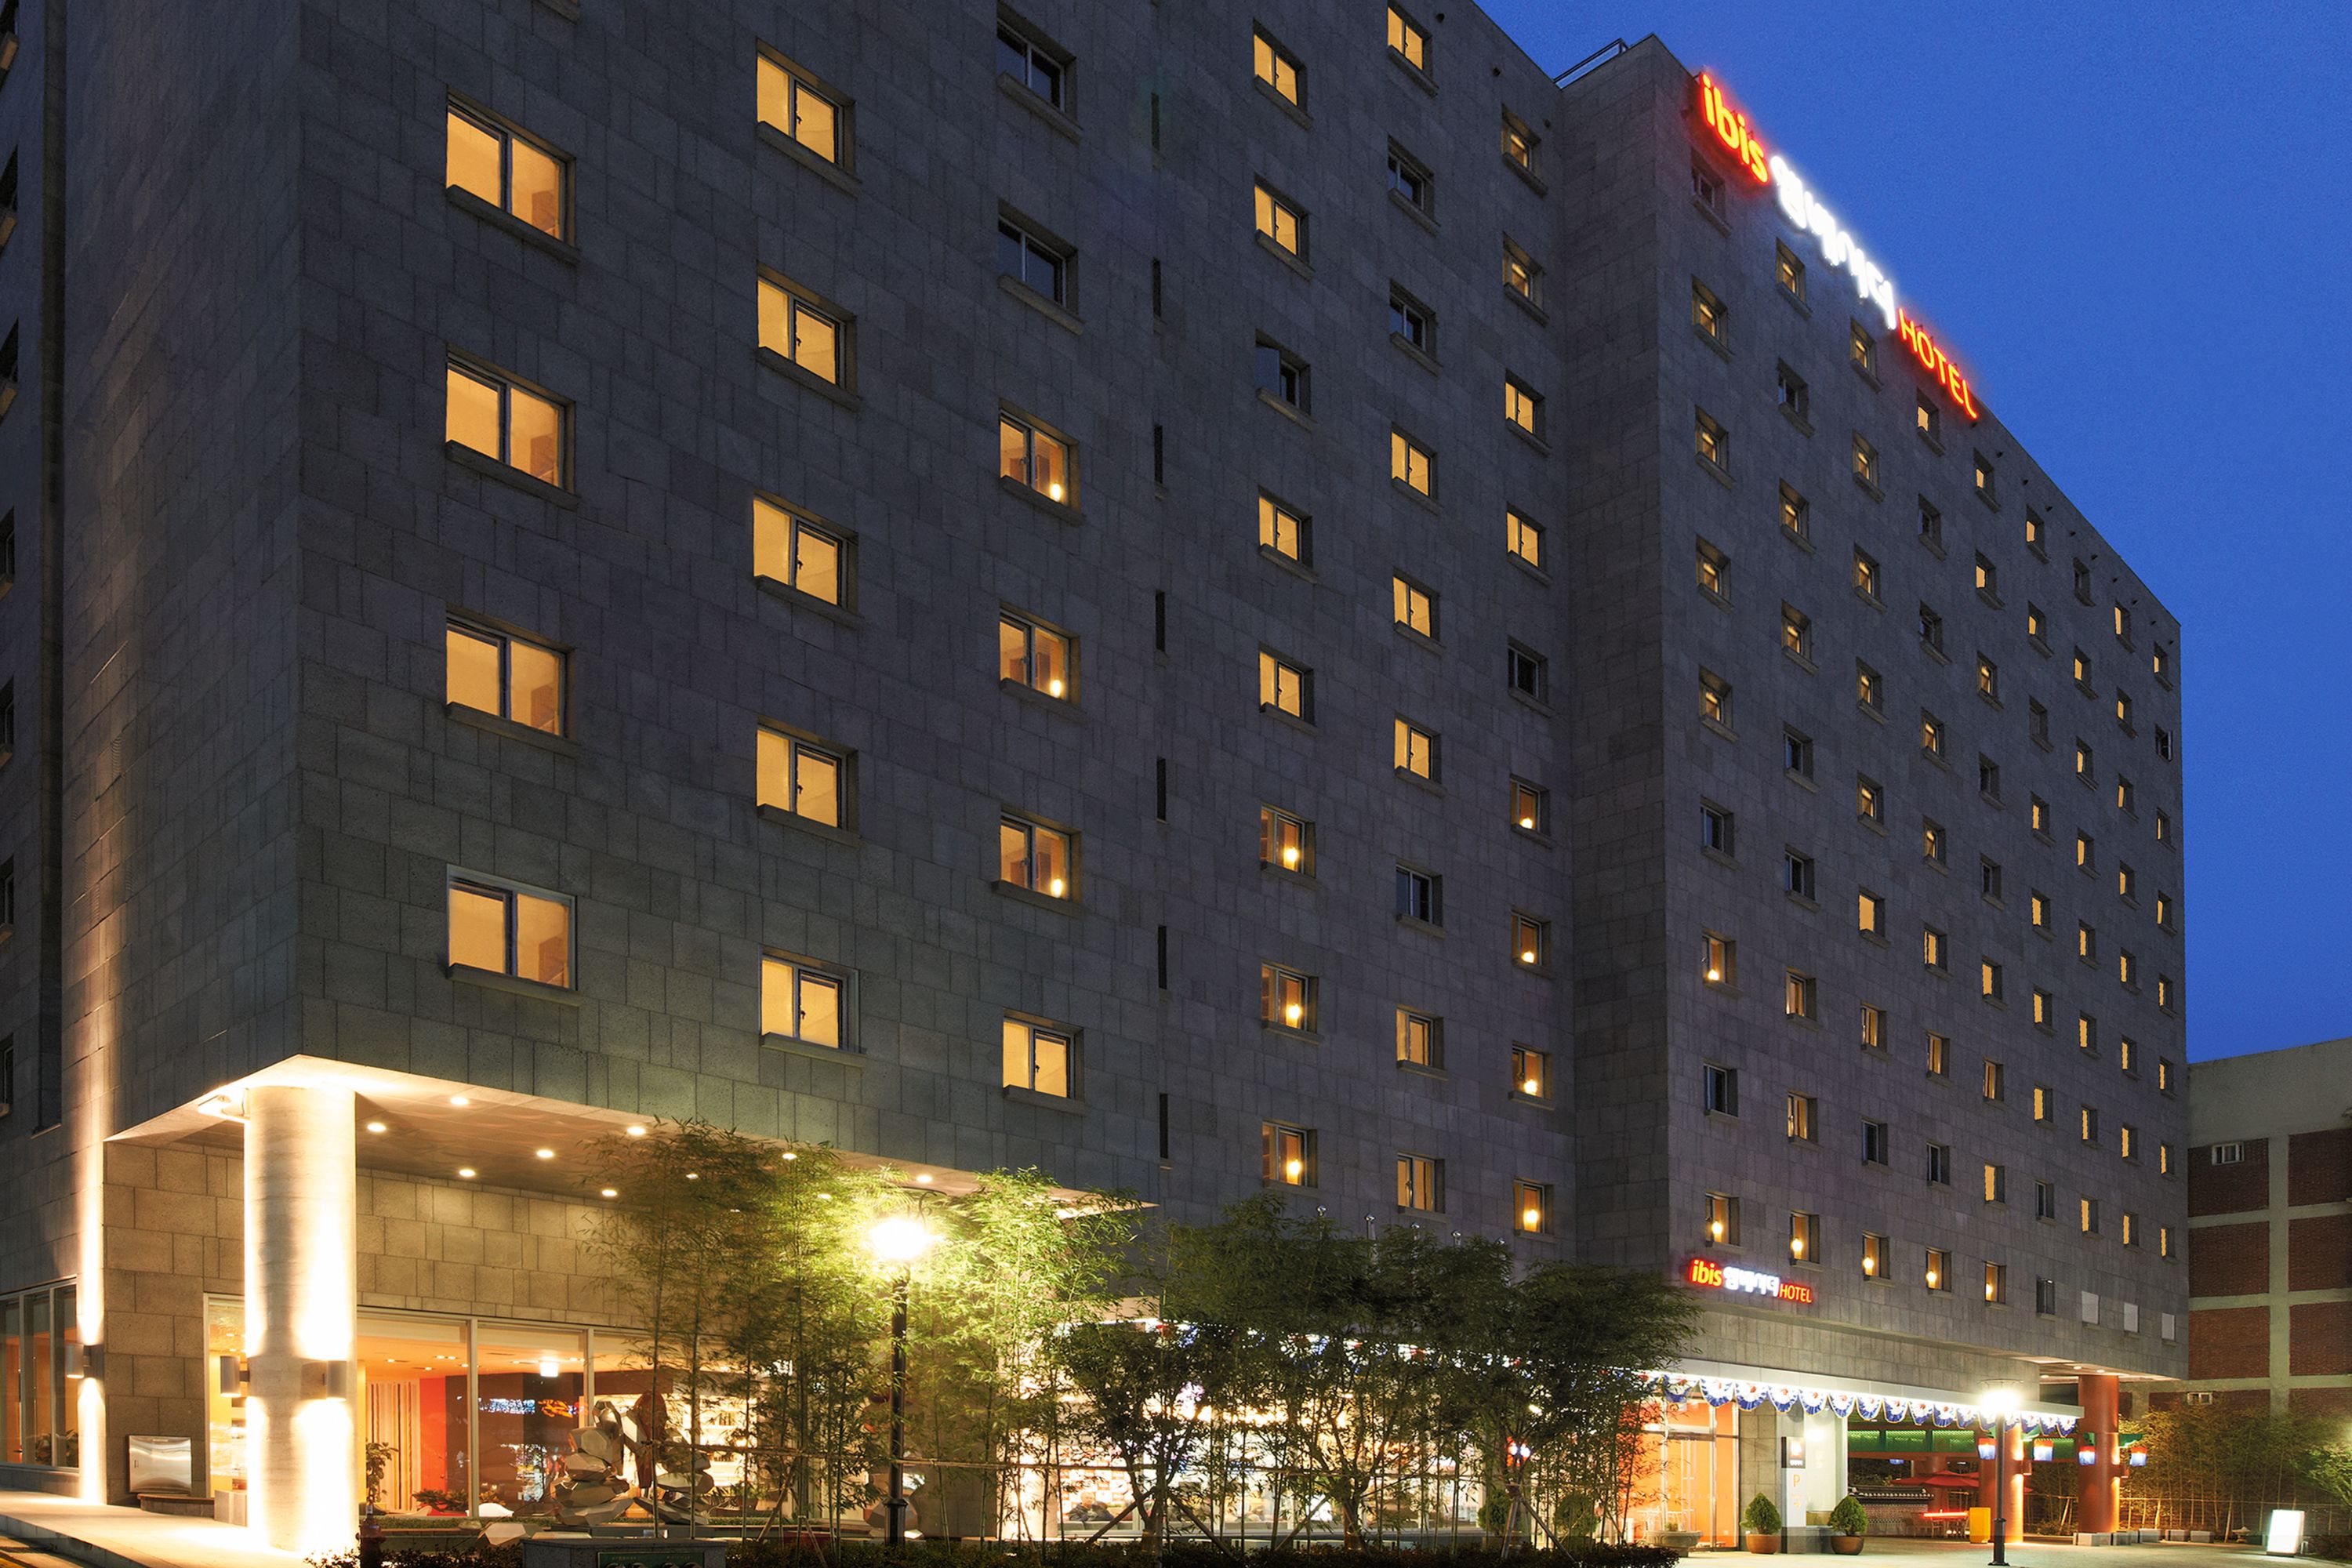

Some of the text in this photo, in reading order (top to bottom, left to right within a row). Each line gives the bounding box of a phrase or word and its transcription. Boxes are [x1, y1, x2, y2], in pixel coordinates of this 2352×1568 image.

[1702, 73, 1768, 183] ibis
[1898, 307, 1977, 419] HOTEL
[1692, 1259, 1722, 1287] ibis
[1780, 1283, 1812, 1303] HOTEL
[1793, 1474, 1801, 1487] P
